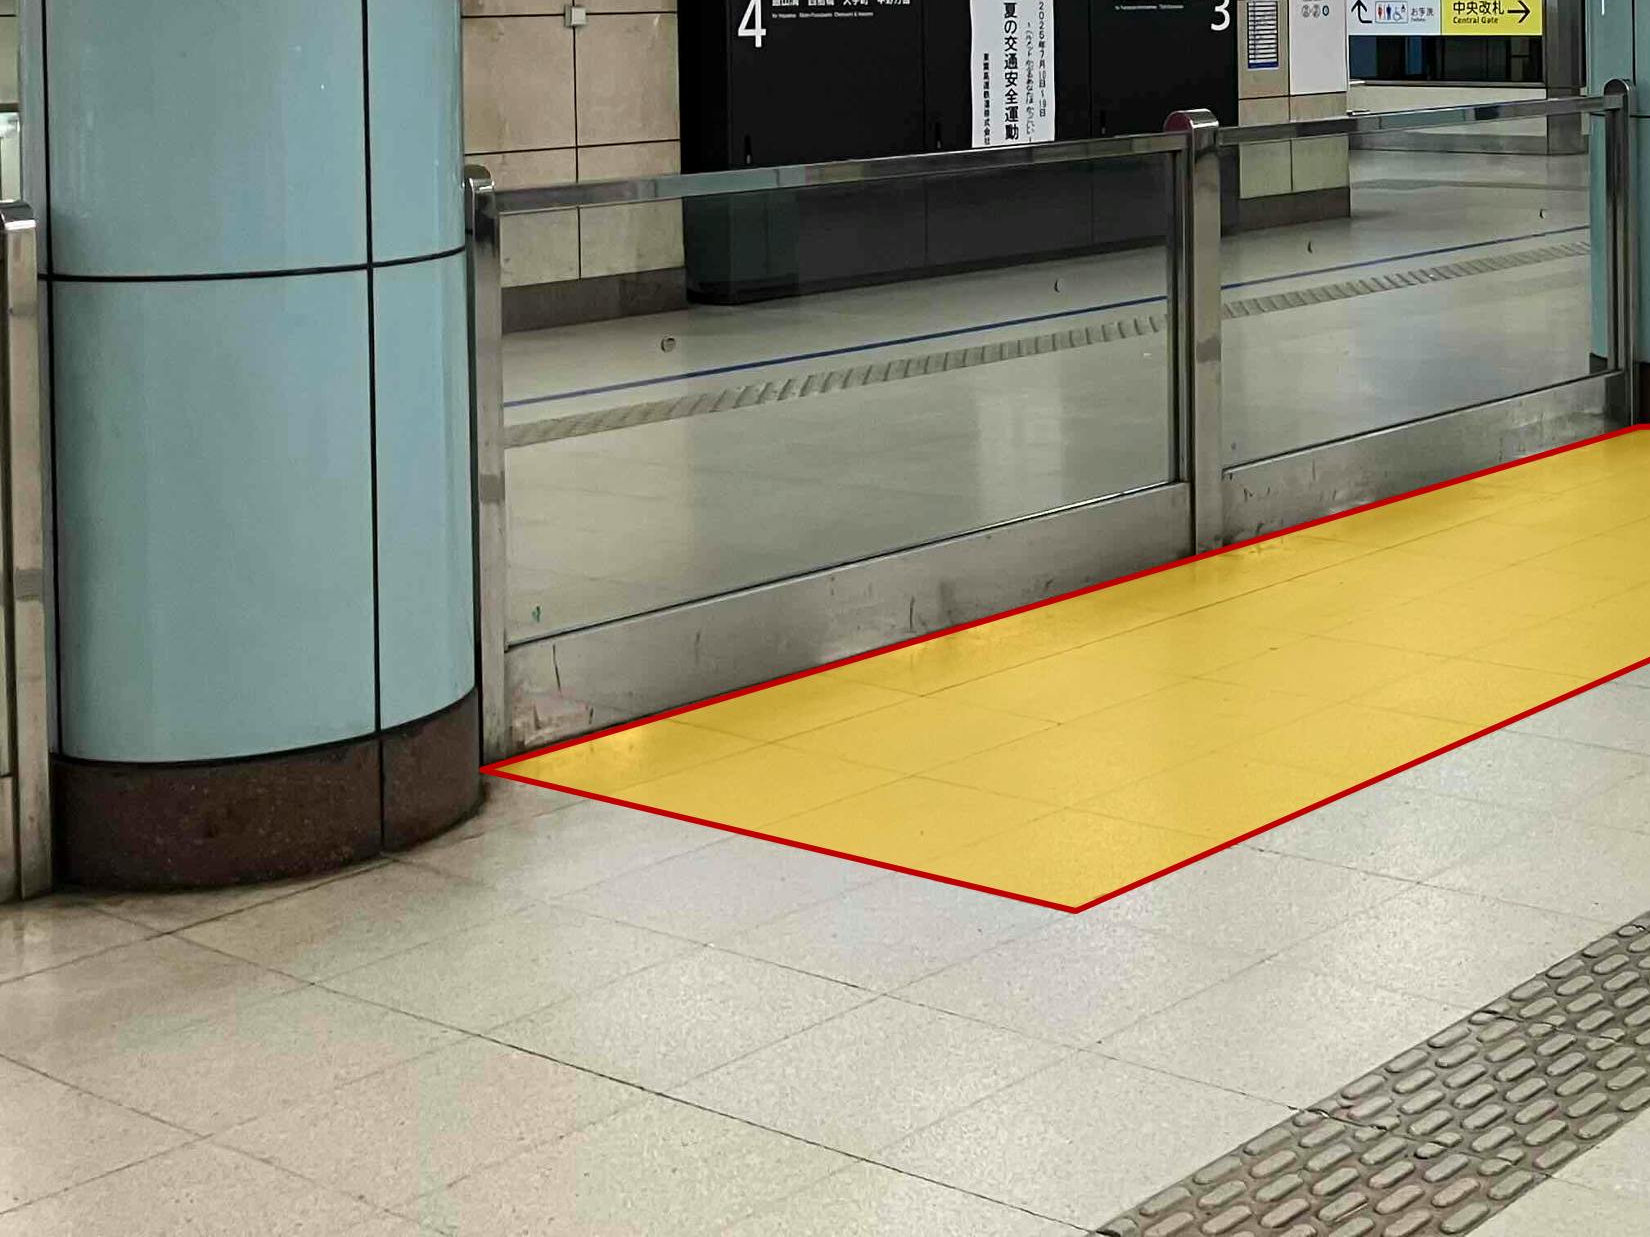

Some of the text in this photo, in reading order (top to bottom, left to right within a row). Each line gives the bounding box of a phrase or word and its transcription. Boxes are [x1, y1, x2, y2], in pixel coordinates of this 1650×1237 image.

[1452, 0, 1505, 16] 中央改札
[1452, 15, 1499, 25] Central Gate
[1003, 1, 1020, 141] 夏の交通安全運動
